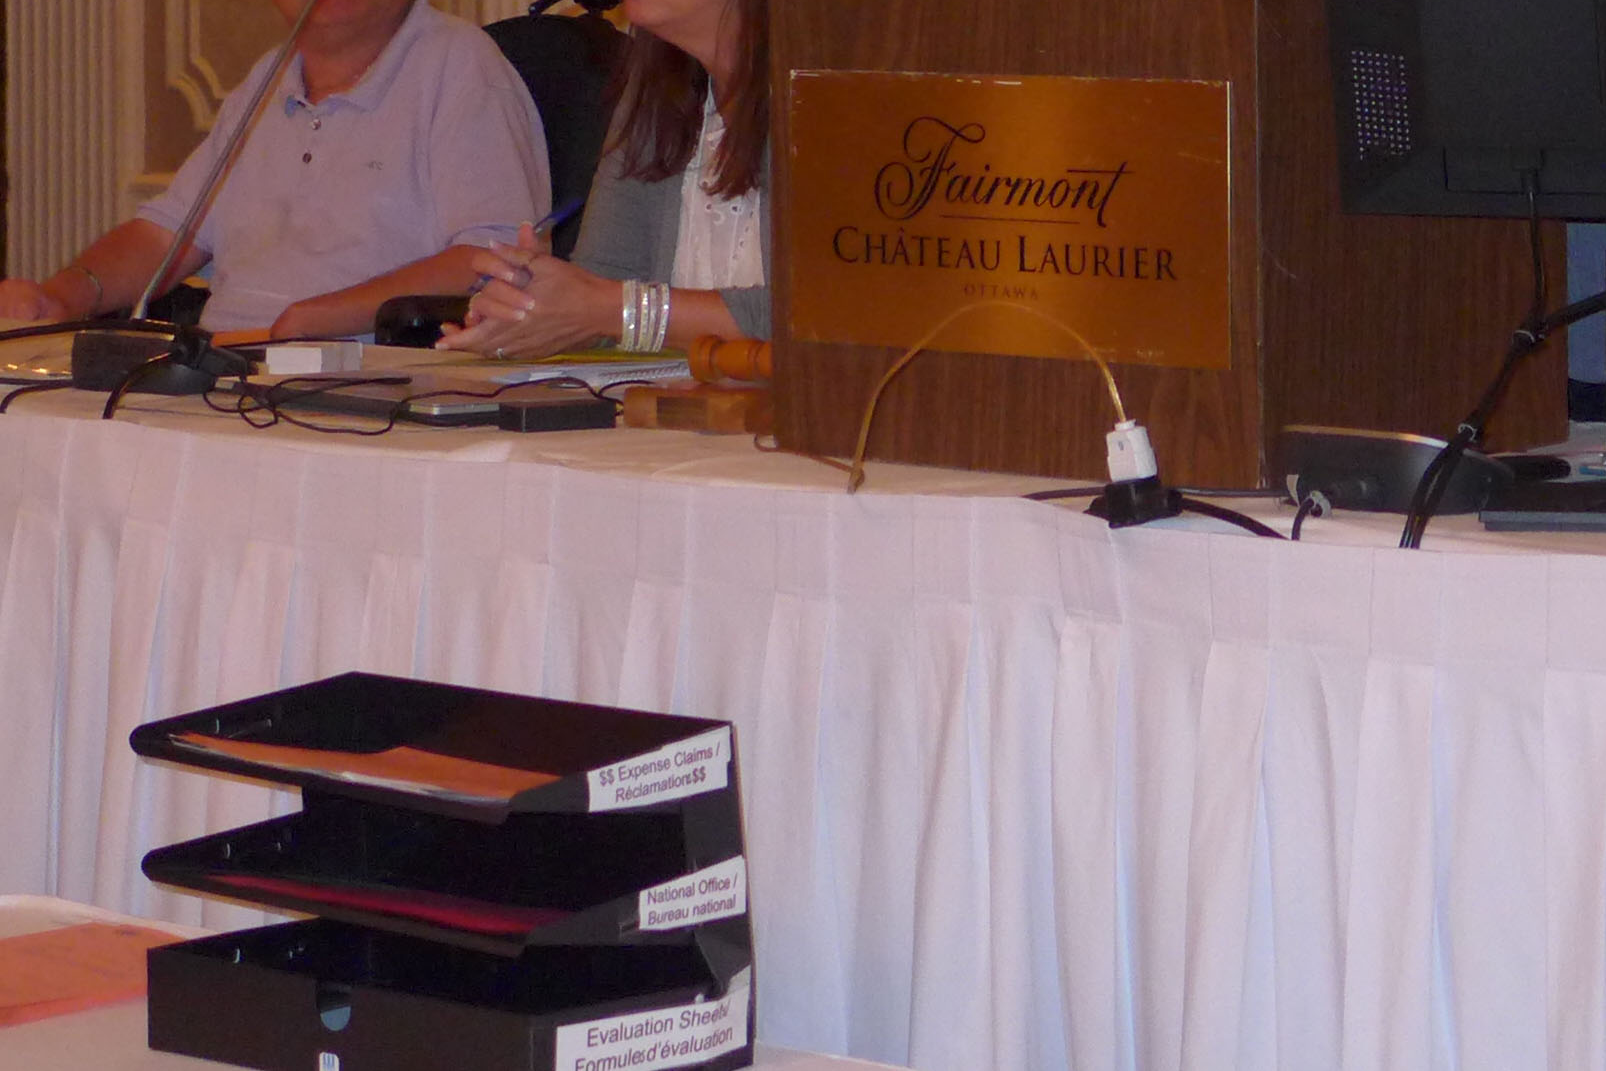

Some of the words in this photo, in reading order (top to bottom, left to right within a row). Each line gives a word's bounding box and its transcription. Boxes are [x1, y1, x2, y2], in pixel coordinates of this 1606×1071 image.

[874, 116, 1135, 228] Fairmont
[832, 226, 1001, 272] CHÂTEAU
[1017, 235, 1178, 281] LAURIER
[963, 283, 1039, 301] OTTAWA
[599, 768, 615, 787] $$
[617, 757, 671, 782] Expense
[673, 746, 713, 767] Claims
[647, 882, 695, 905] National
[698, 876, 731, 895] Office
[647, 908, 689, 926] Bureau
[692, 893, 737, 917] national
[587, 1016, 674, 1048] Evaluation
